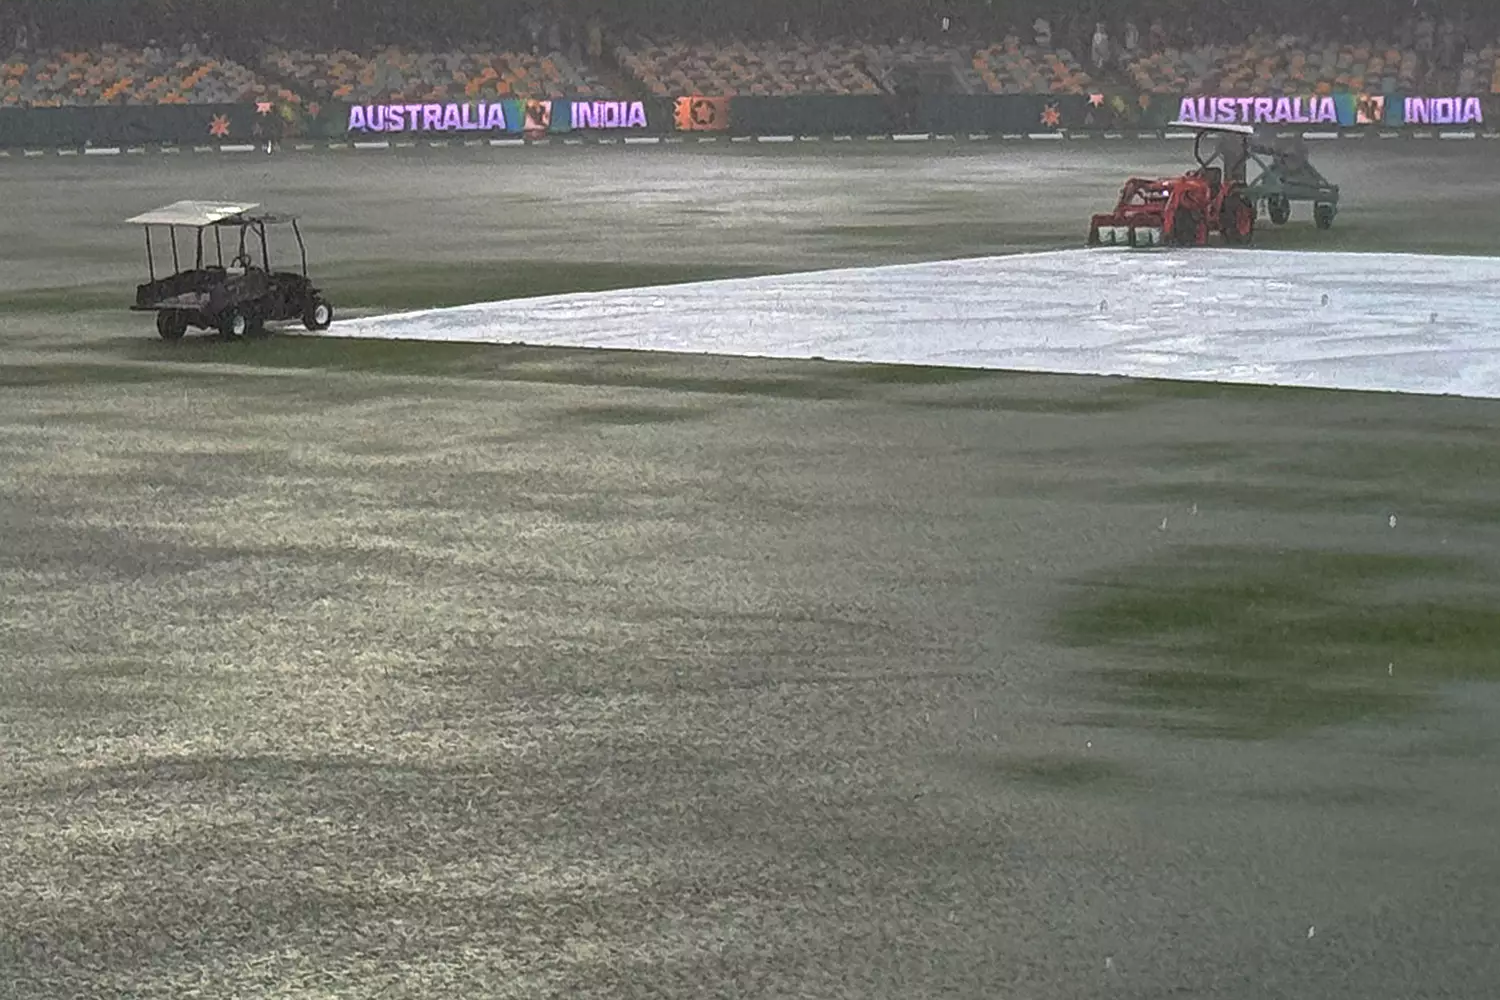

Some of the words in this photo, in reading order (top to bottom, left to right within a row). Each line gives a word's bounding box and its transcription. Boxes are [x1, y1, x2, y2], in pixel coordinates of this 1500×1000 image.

[348, 100, 507, 132] AUSTRALIA
[571, 100, 648, 129] INDIA
[1178, 96, 1339, 125] AUSTRALIA
[1404, 96, 1484, 125] INDIA
